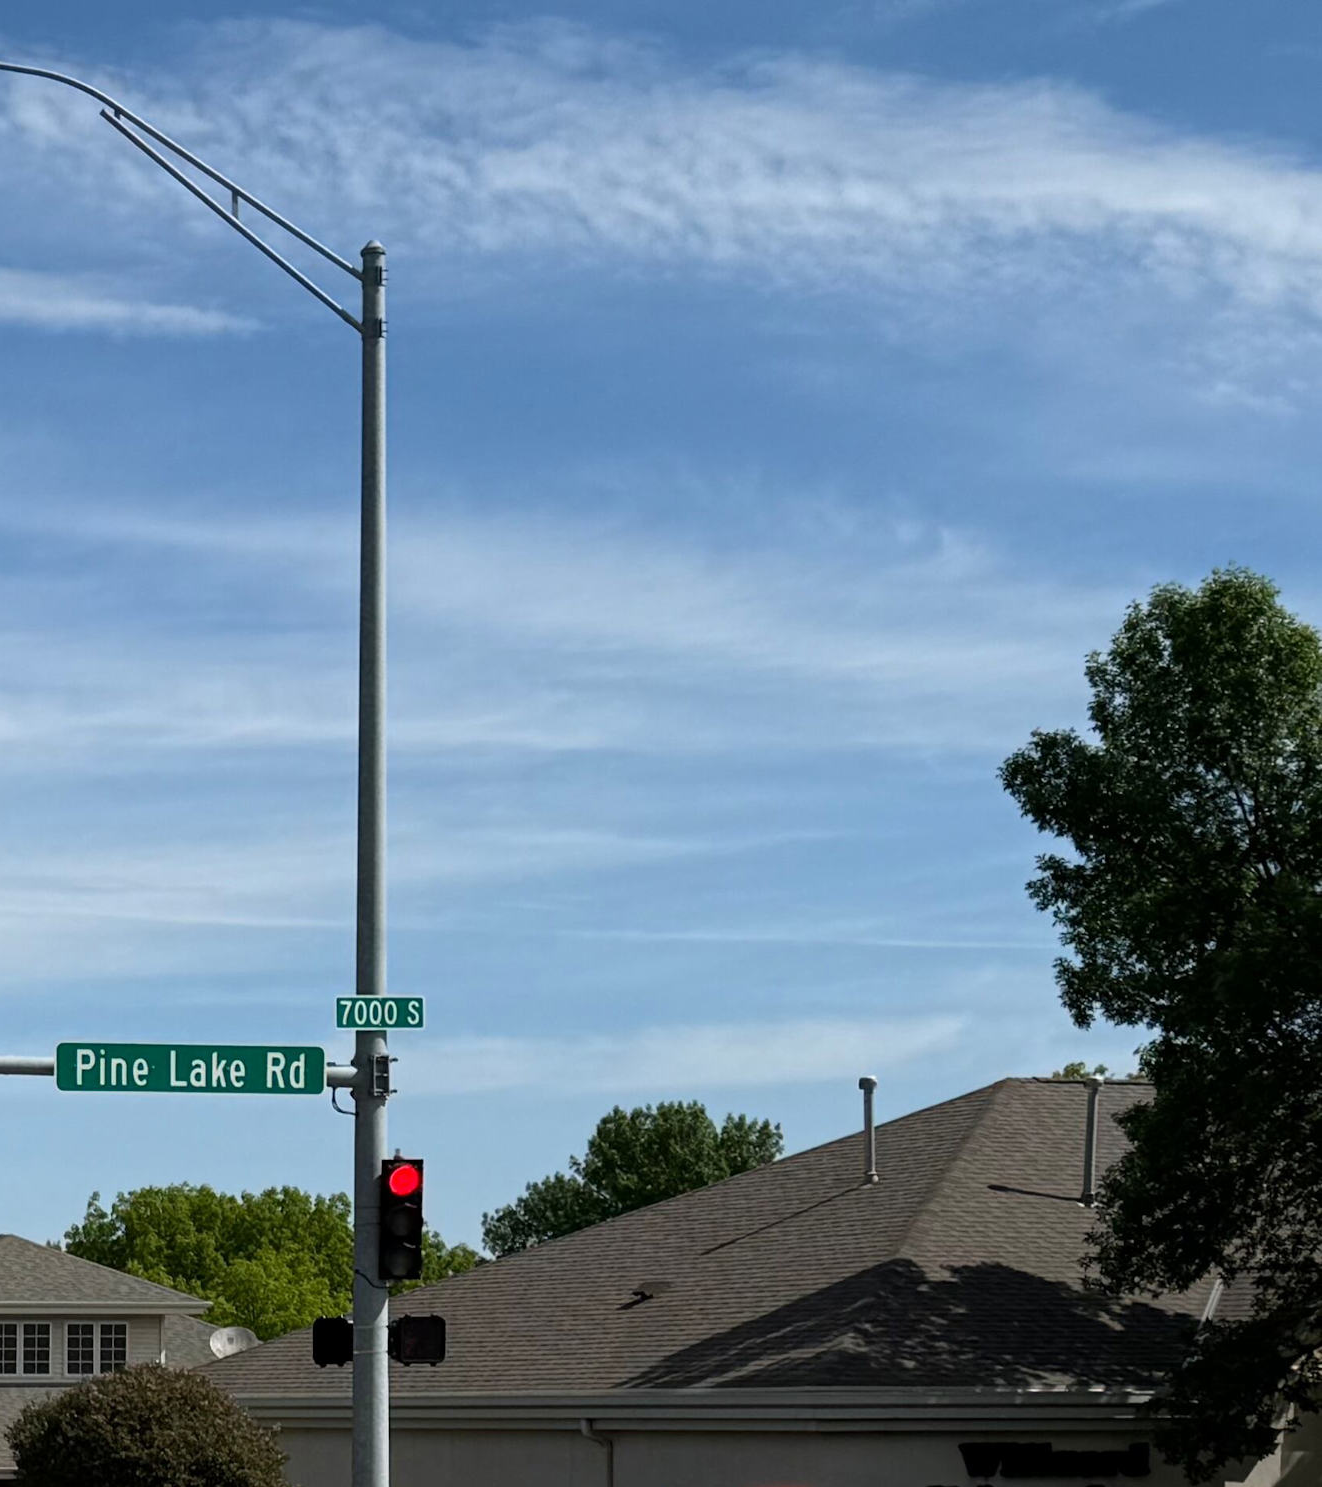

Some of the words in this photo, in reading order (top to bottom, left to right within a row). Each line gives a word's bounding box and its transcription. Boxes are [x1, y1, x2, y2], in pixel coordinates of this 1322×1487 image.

[340, 1000, 397, 1025] 7000
[407, 1001, 420, 1025] S
[75, 1048, 149, 1087] Pine
[169, 1050, 246, 1088] Lake
[266, 1052, 306, 1089] Rd
